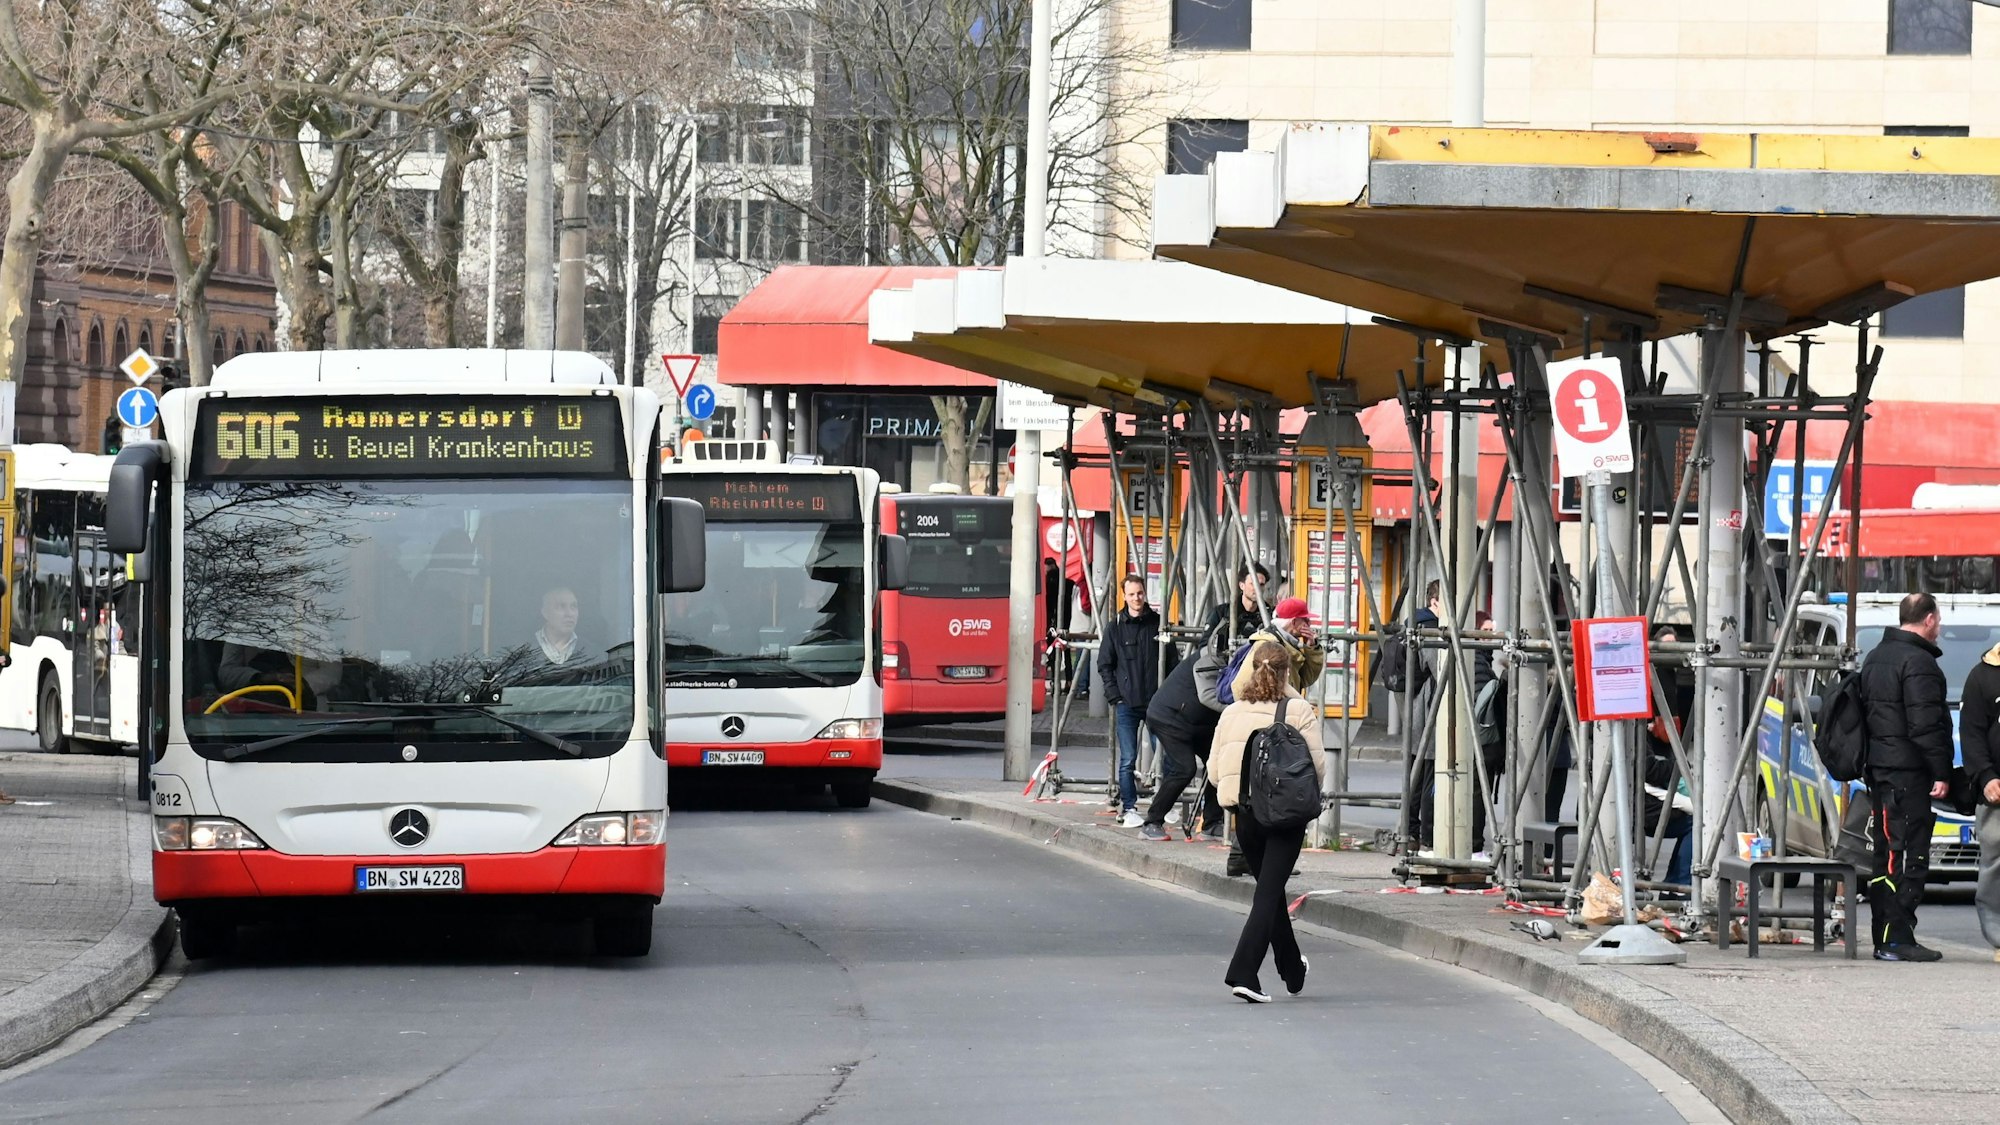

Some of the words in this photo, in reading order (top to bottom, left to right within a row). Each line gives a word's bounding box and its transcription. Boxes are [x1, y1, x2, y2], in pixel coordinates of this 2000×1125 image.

[322, 405, 534, 429] Ramersdorf
[869, 417, 983, 437] PRIMA
[217, 411, 300, 460] 606
[313, 437, 334, 459] ü.
[347, 436, 415, 458] Beuel
[428, 436, 593, 458] Krankenhaus
[1605, 454, 1630, 463] SWB
[724, 481, 789, 494] Mehlem
[709, 496, 805, 510] Rheinallee
[917, 514, 939, 526] 2004
[963, 619, 992, 630] SWB
[708, 753, 720, 763] BN
[727, 753, 740, 763] SW
[156, 792, 182, 806] 0812
[368, 871, 387, 887] BN
[399, 870, 418, 886] SW
[423, 870, 460, 886] 4228
